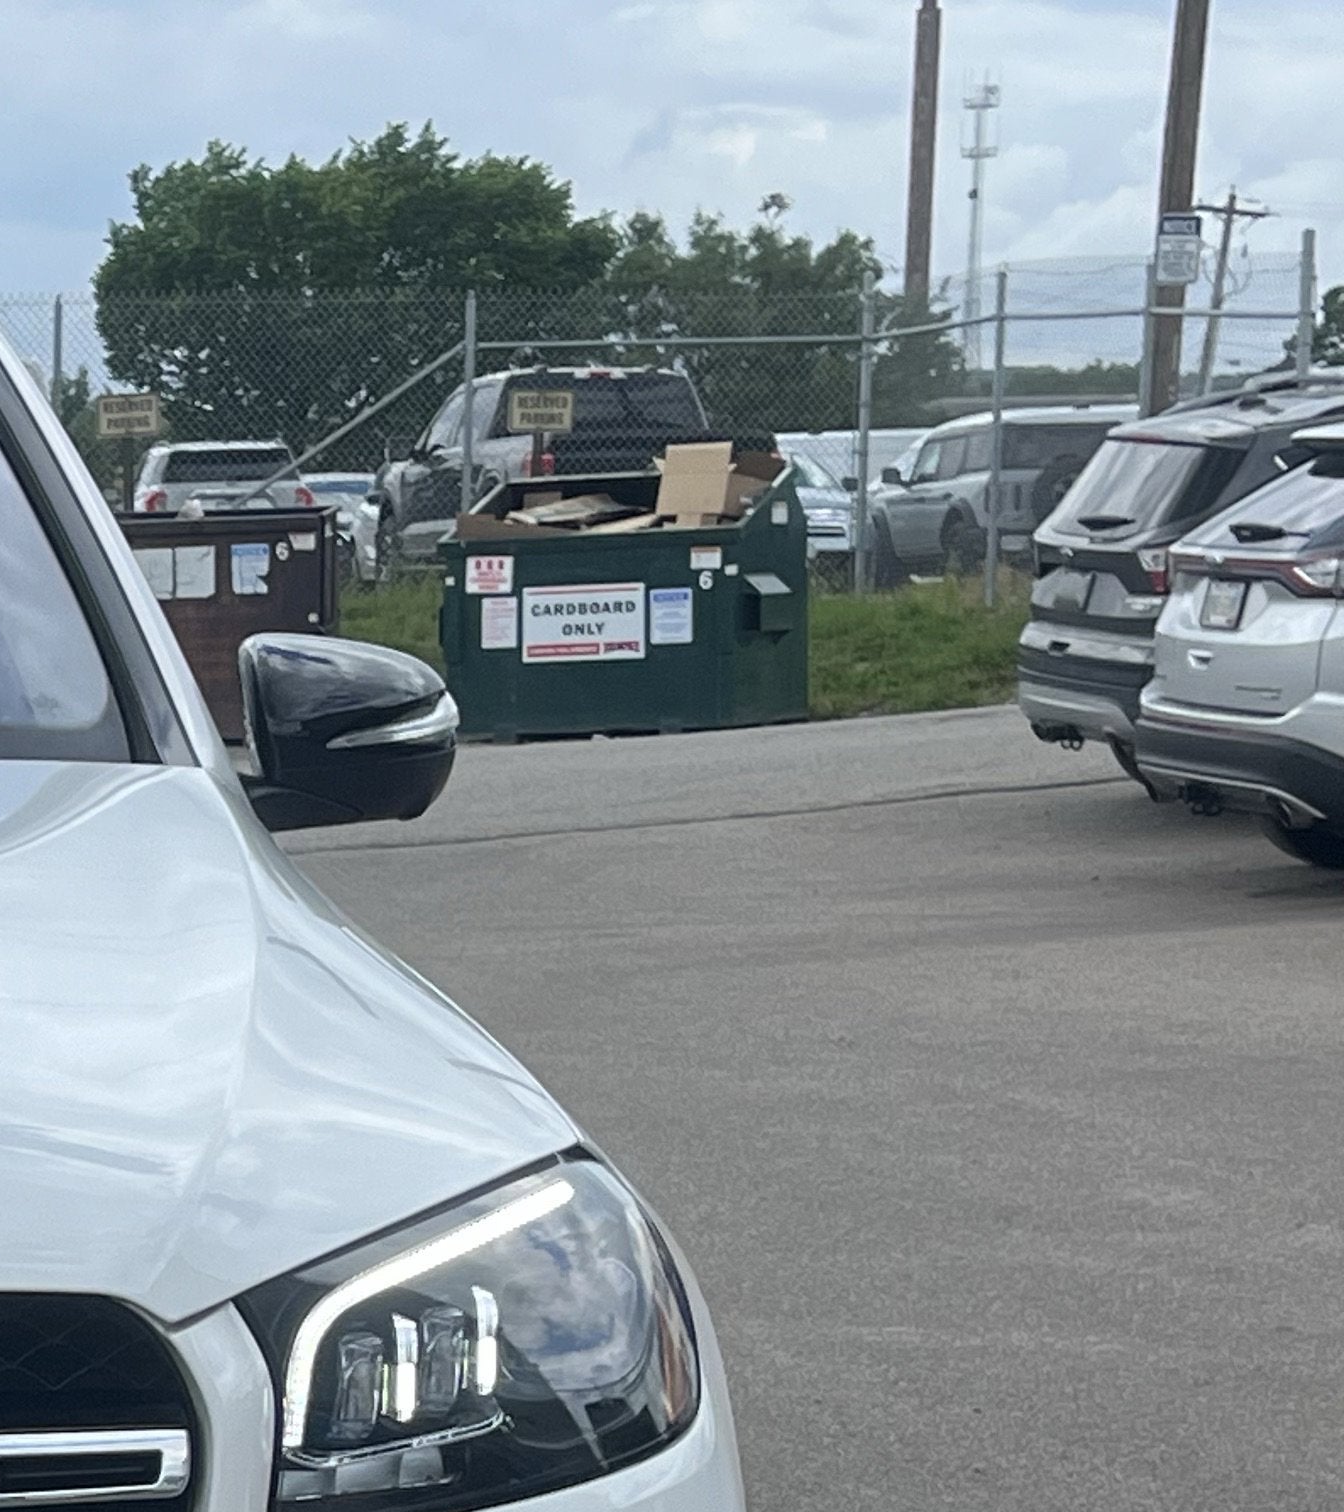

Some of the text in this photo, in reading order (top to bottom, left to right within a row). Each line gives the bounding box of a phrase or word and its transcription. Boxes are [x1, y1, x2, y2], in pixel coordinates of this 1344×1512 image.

[698, 570, 713, 590] 6
[531, 600, 636, 617] CARDBOARD
[562, 622, 605, 636] ONLY
